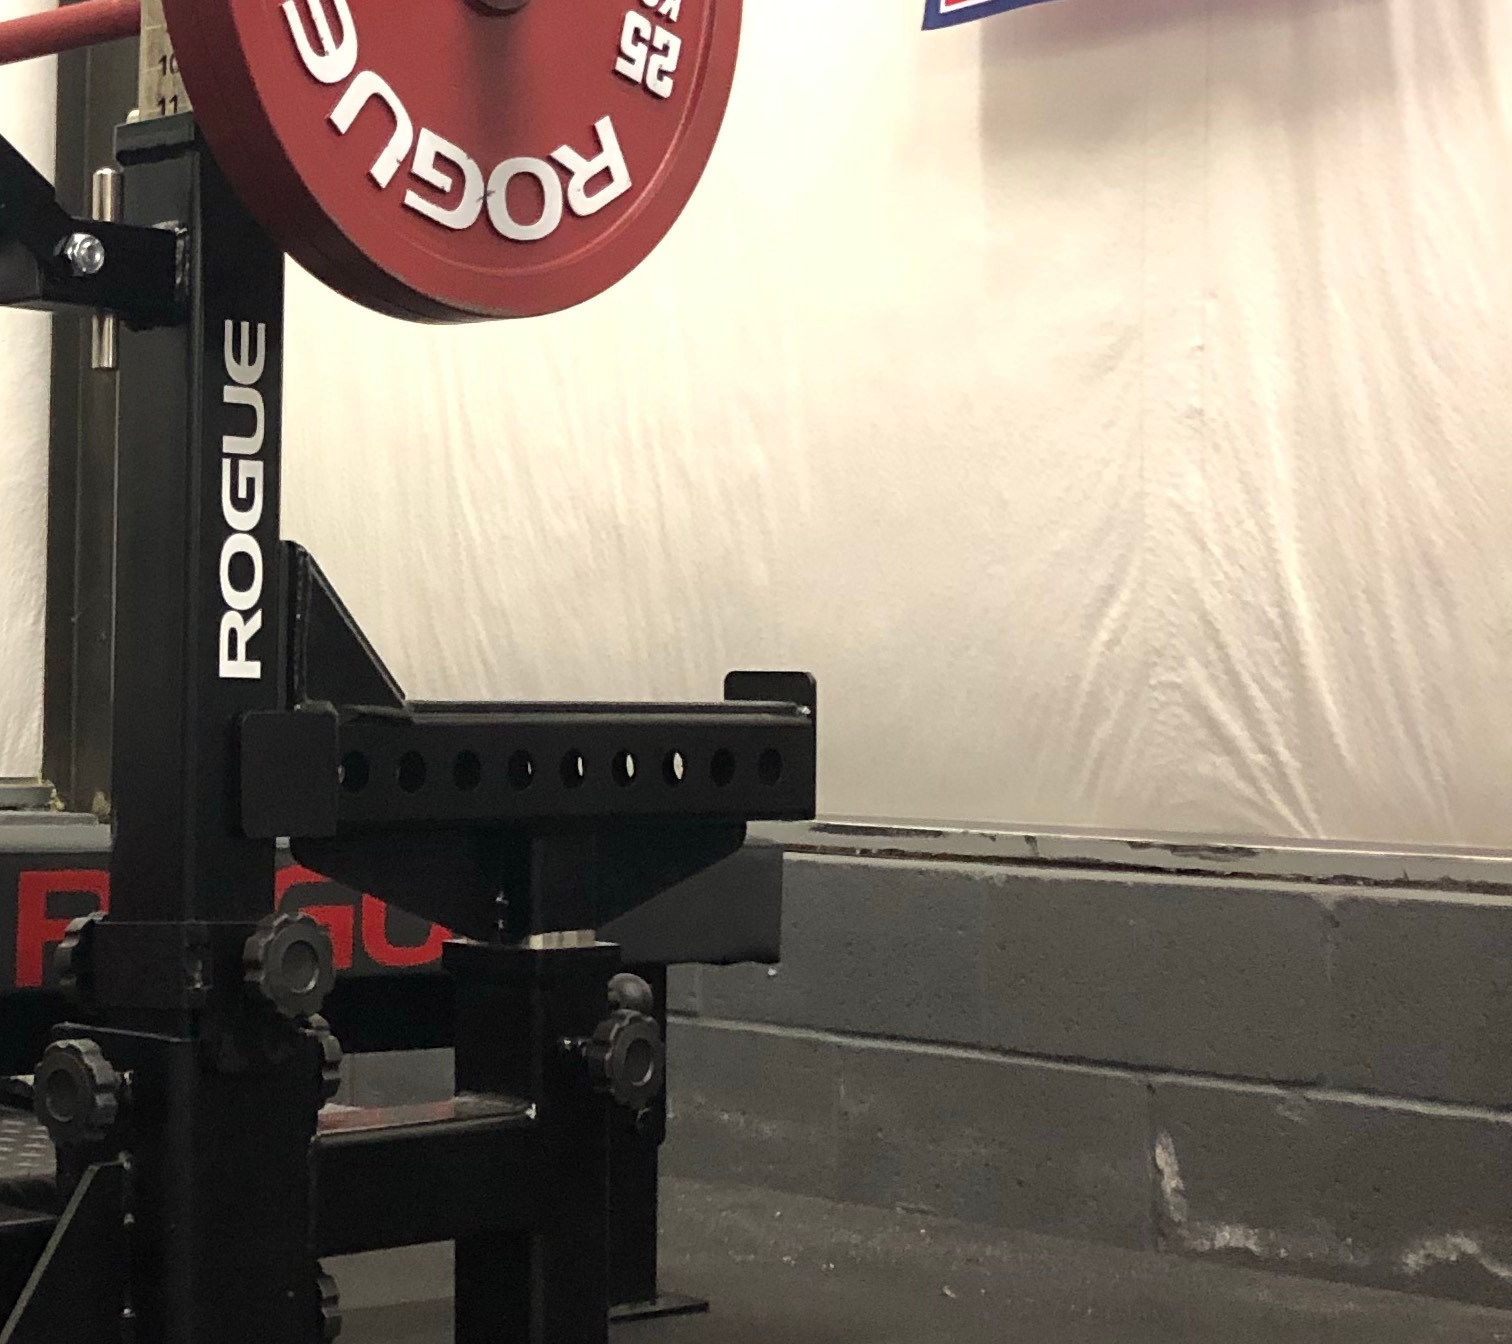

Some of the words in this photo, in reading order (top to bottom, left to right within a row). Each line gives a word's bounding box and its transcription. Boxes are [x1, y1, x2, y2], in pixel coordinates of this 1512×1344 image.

[615, 9, 682, 100] 25
[158, 94, 179, 116] 11
[218, 318, 267, 680] ROGUE
